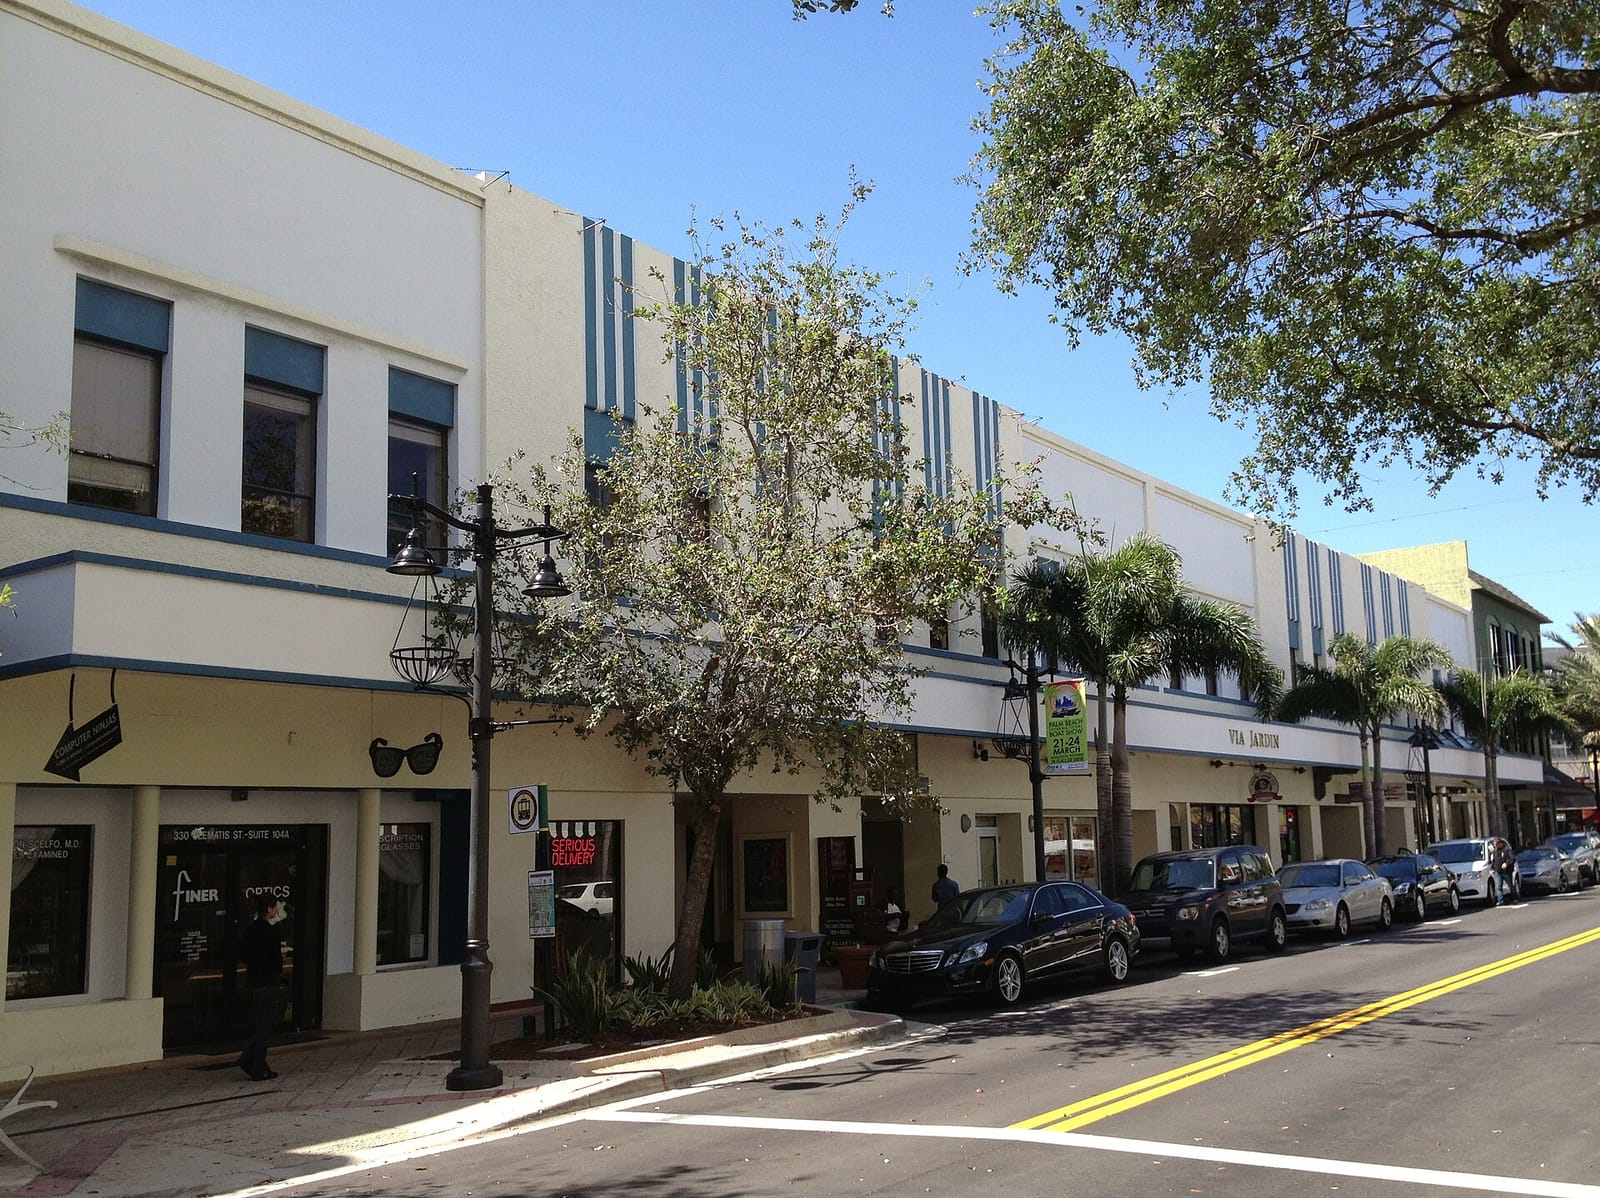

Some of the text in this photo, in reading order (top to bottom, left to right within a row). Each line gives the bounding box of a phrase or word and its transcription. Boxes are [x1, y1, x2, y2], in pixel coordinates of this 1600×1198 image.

[1065, 718, 1083, 726] BEACH
[55, 730, 93, 759] COMPUTER
[93, 713, 118, 736] NINJAS
[1049, 730, 1064, 738] BOAT
[1228, 729, 1280, 749] VIA JARDIN
[1053, 736, 1080, 748] 21-24
[1053, 746, 1081, 755] MARCH
[174, 831, 190, 841] 330
[272, 830, 290, 840] 104A
[28, 839, 62, 850] SCELFO,
[65, 839, 82, 848] M.D.
[381, 842, 421, 851] GLASSES
[551, 838, 596, 853] SERIOUS
[27, 850, 69, 859] EXAMINED
[551, 851, 596, 866] DELIVERY
